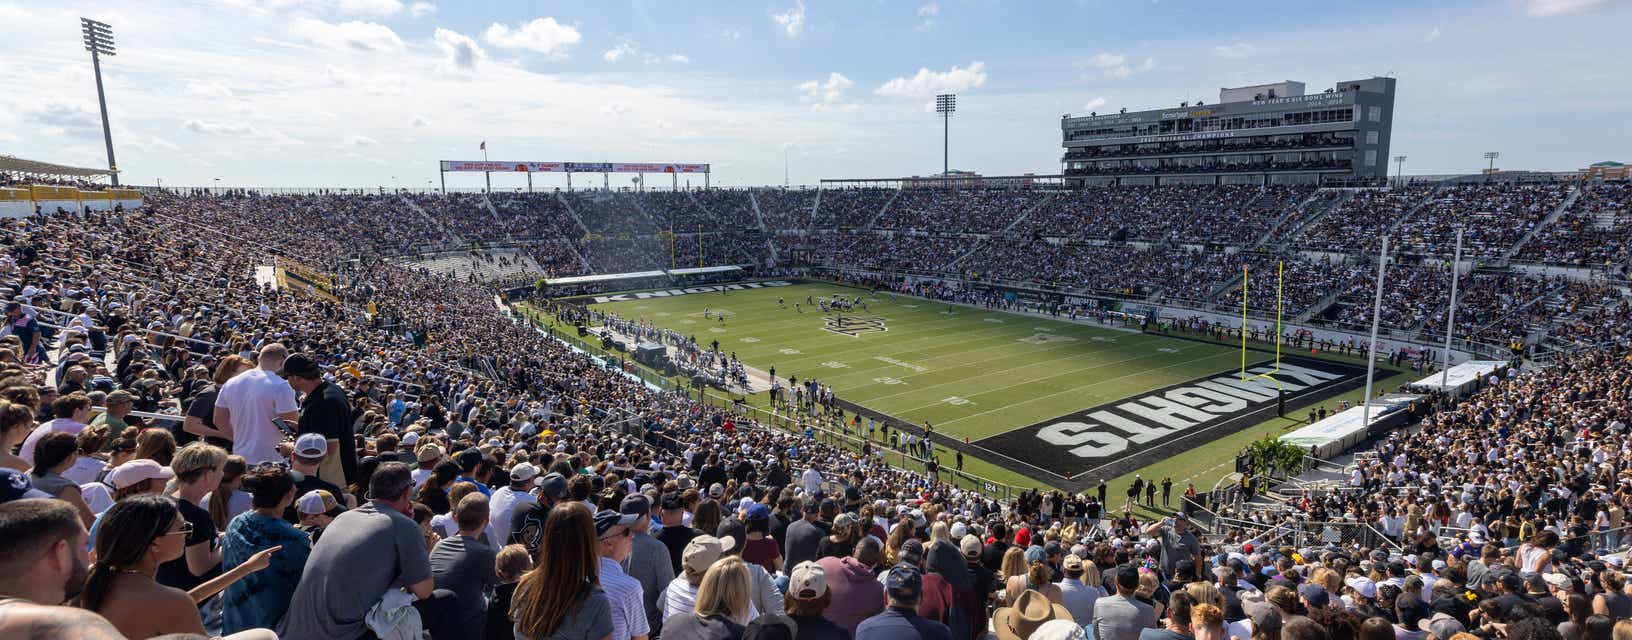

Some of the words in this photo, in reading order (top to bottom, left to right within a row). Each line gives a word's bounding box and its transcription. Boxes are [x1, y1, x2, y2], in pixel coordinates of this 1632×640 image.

[1193, 132, 1234, 140] CHAMPIONS
[593, 281, 792, 303] KNIGHTS
[1063, 295, 1099, 307] KNIGHTS
[1036, 362, 1346, 458] KNIGHTS
[984, 482, 998, 493] 124
